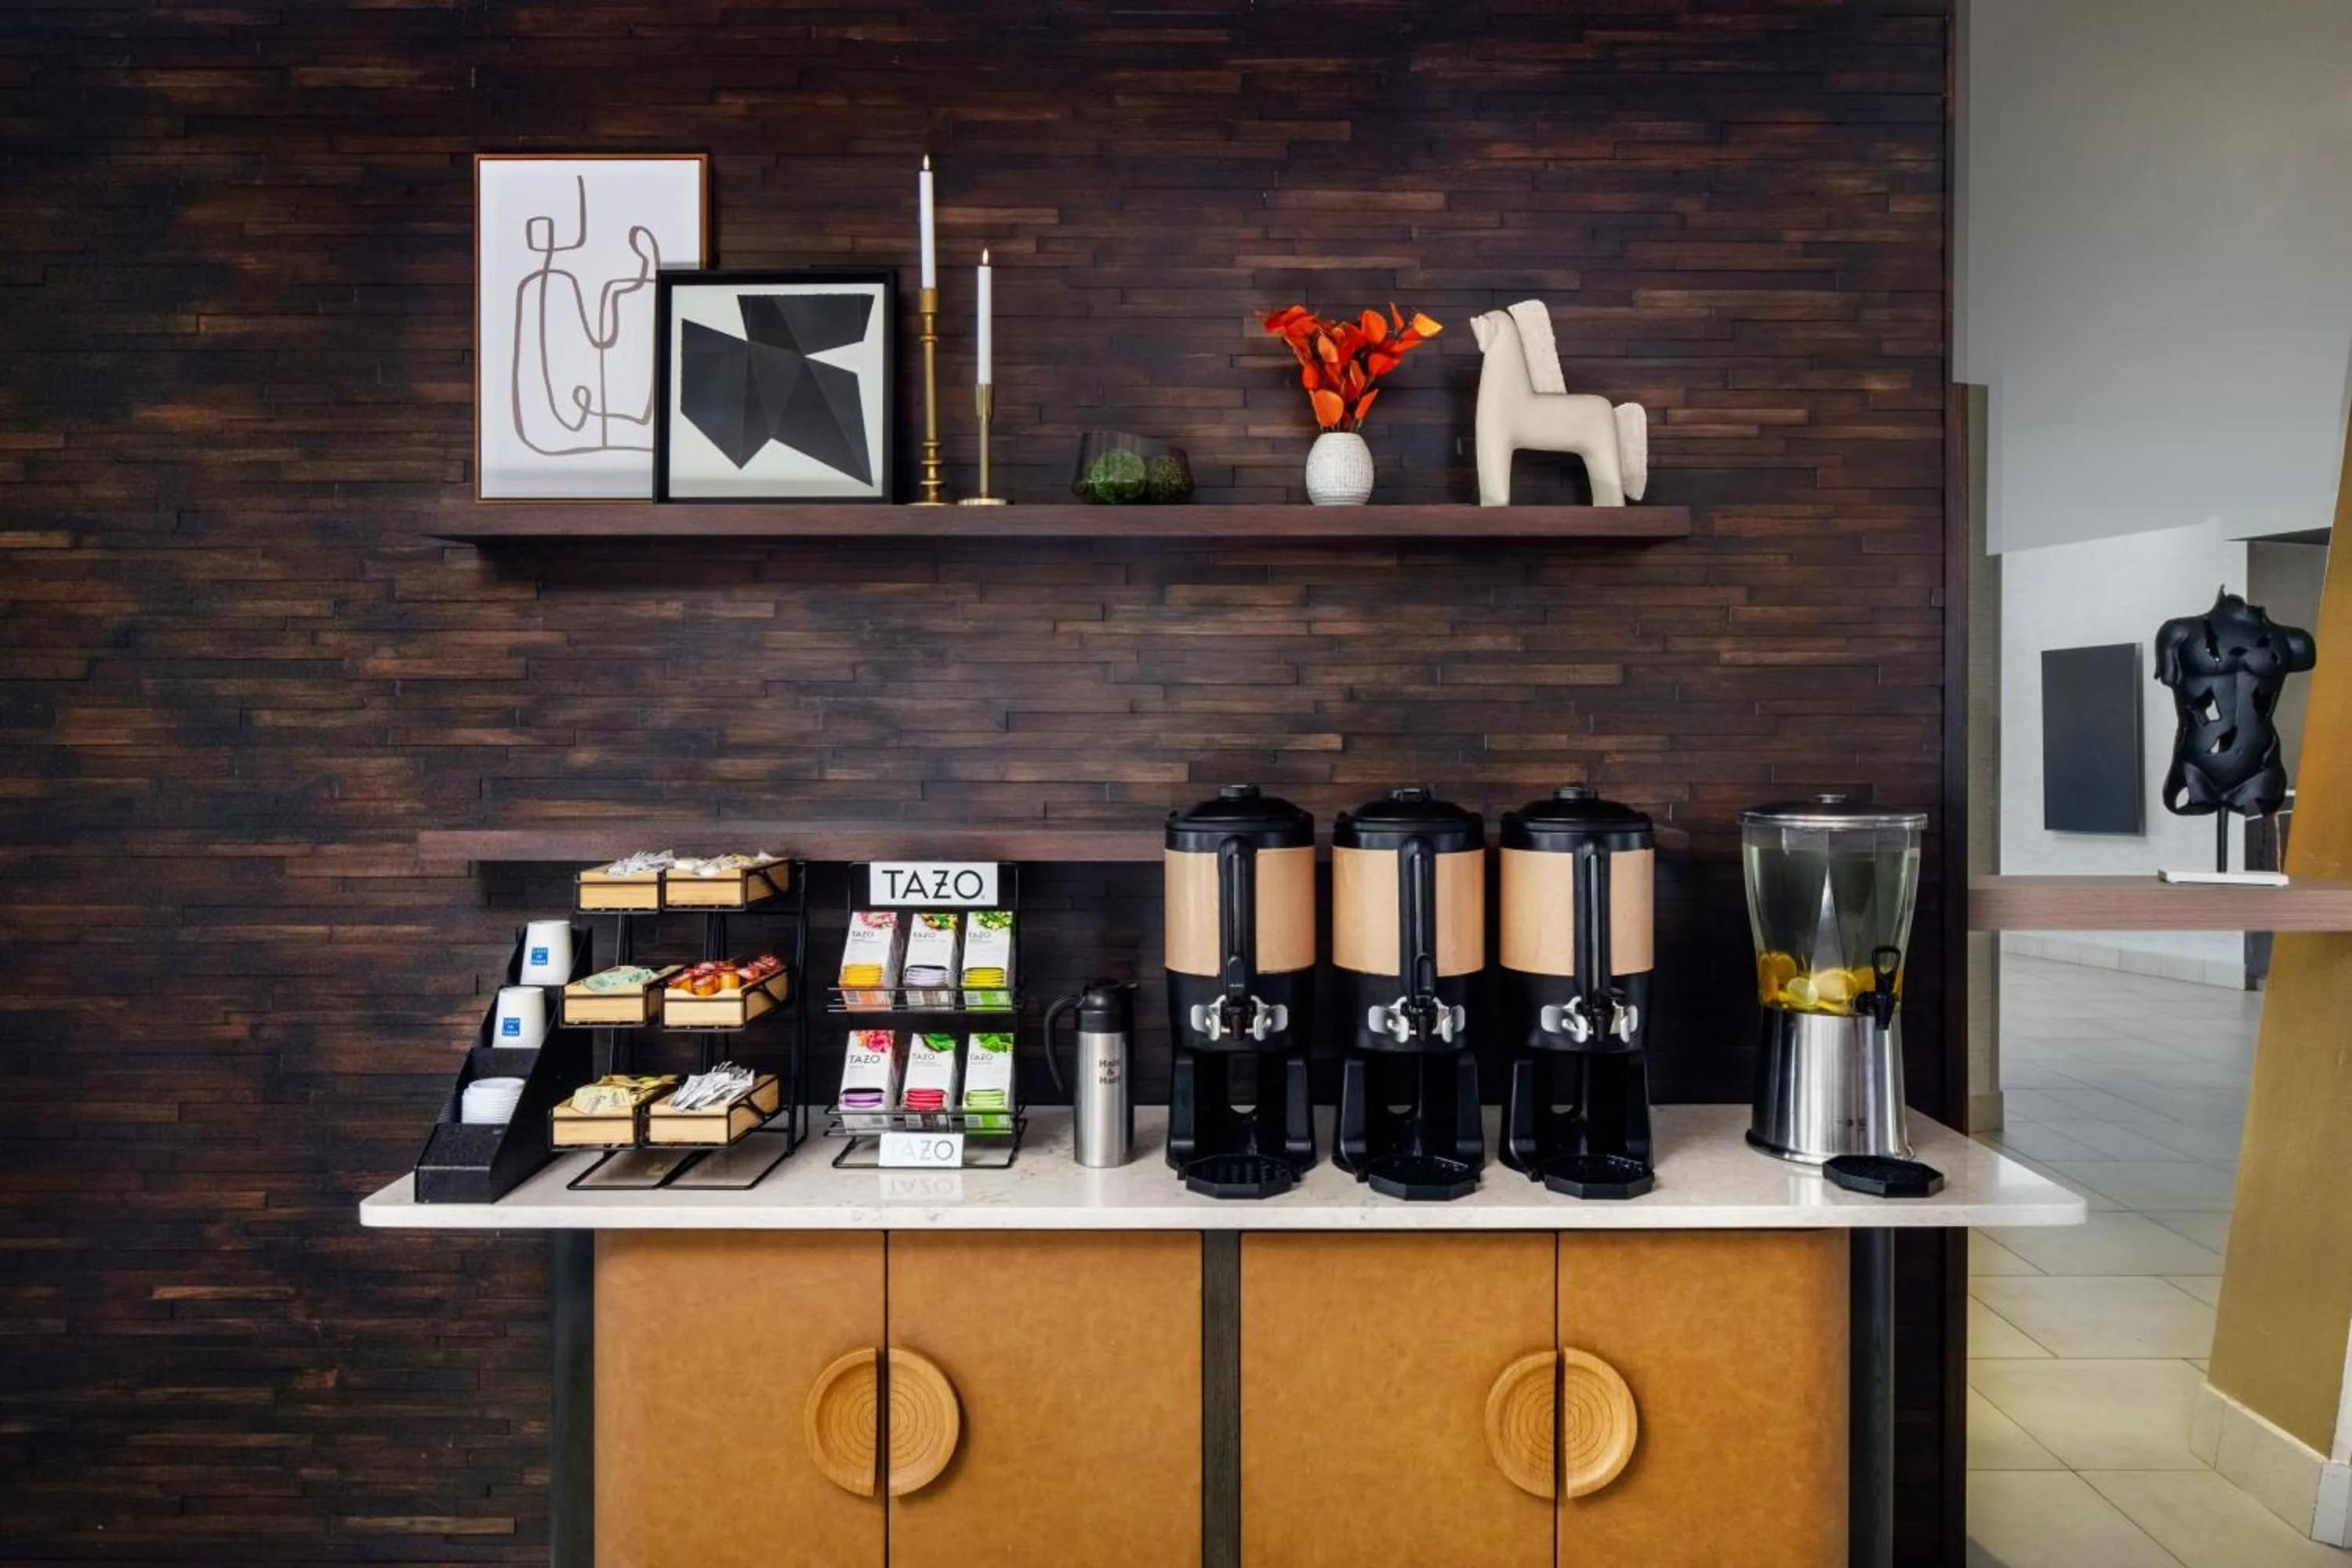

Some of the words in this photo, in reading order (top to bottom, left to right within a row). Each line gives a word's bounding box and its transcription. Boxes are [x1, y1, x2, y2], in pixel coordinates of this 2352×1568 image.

[882, 869, 983, 899] TAZO
[849, 1054, 881, 1065] TAZO
[888, 1139, 955, 1160] AZO
